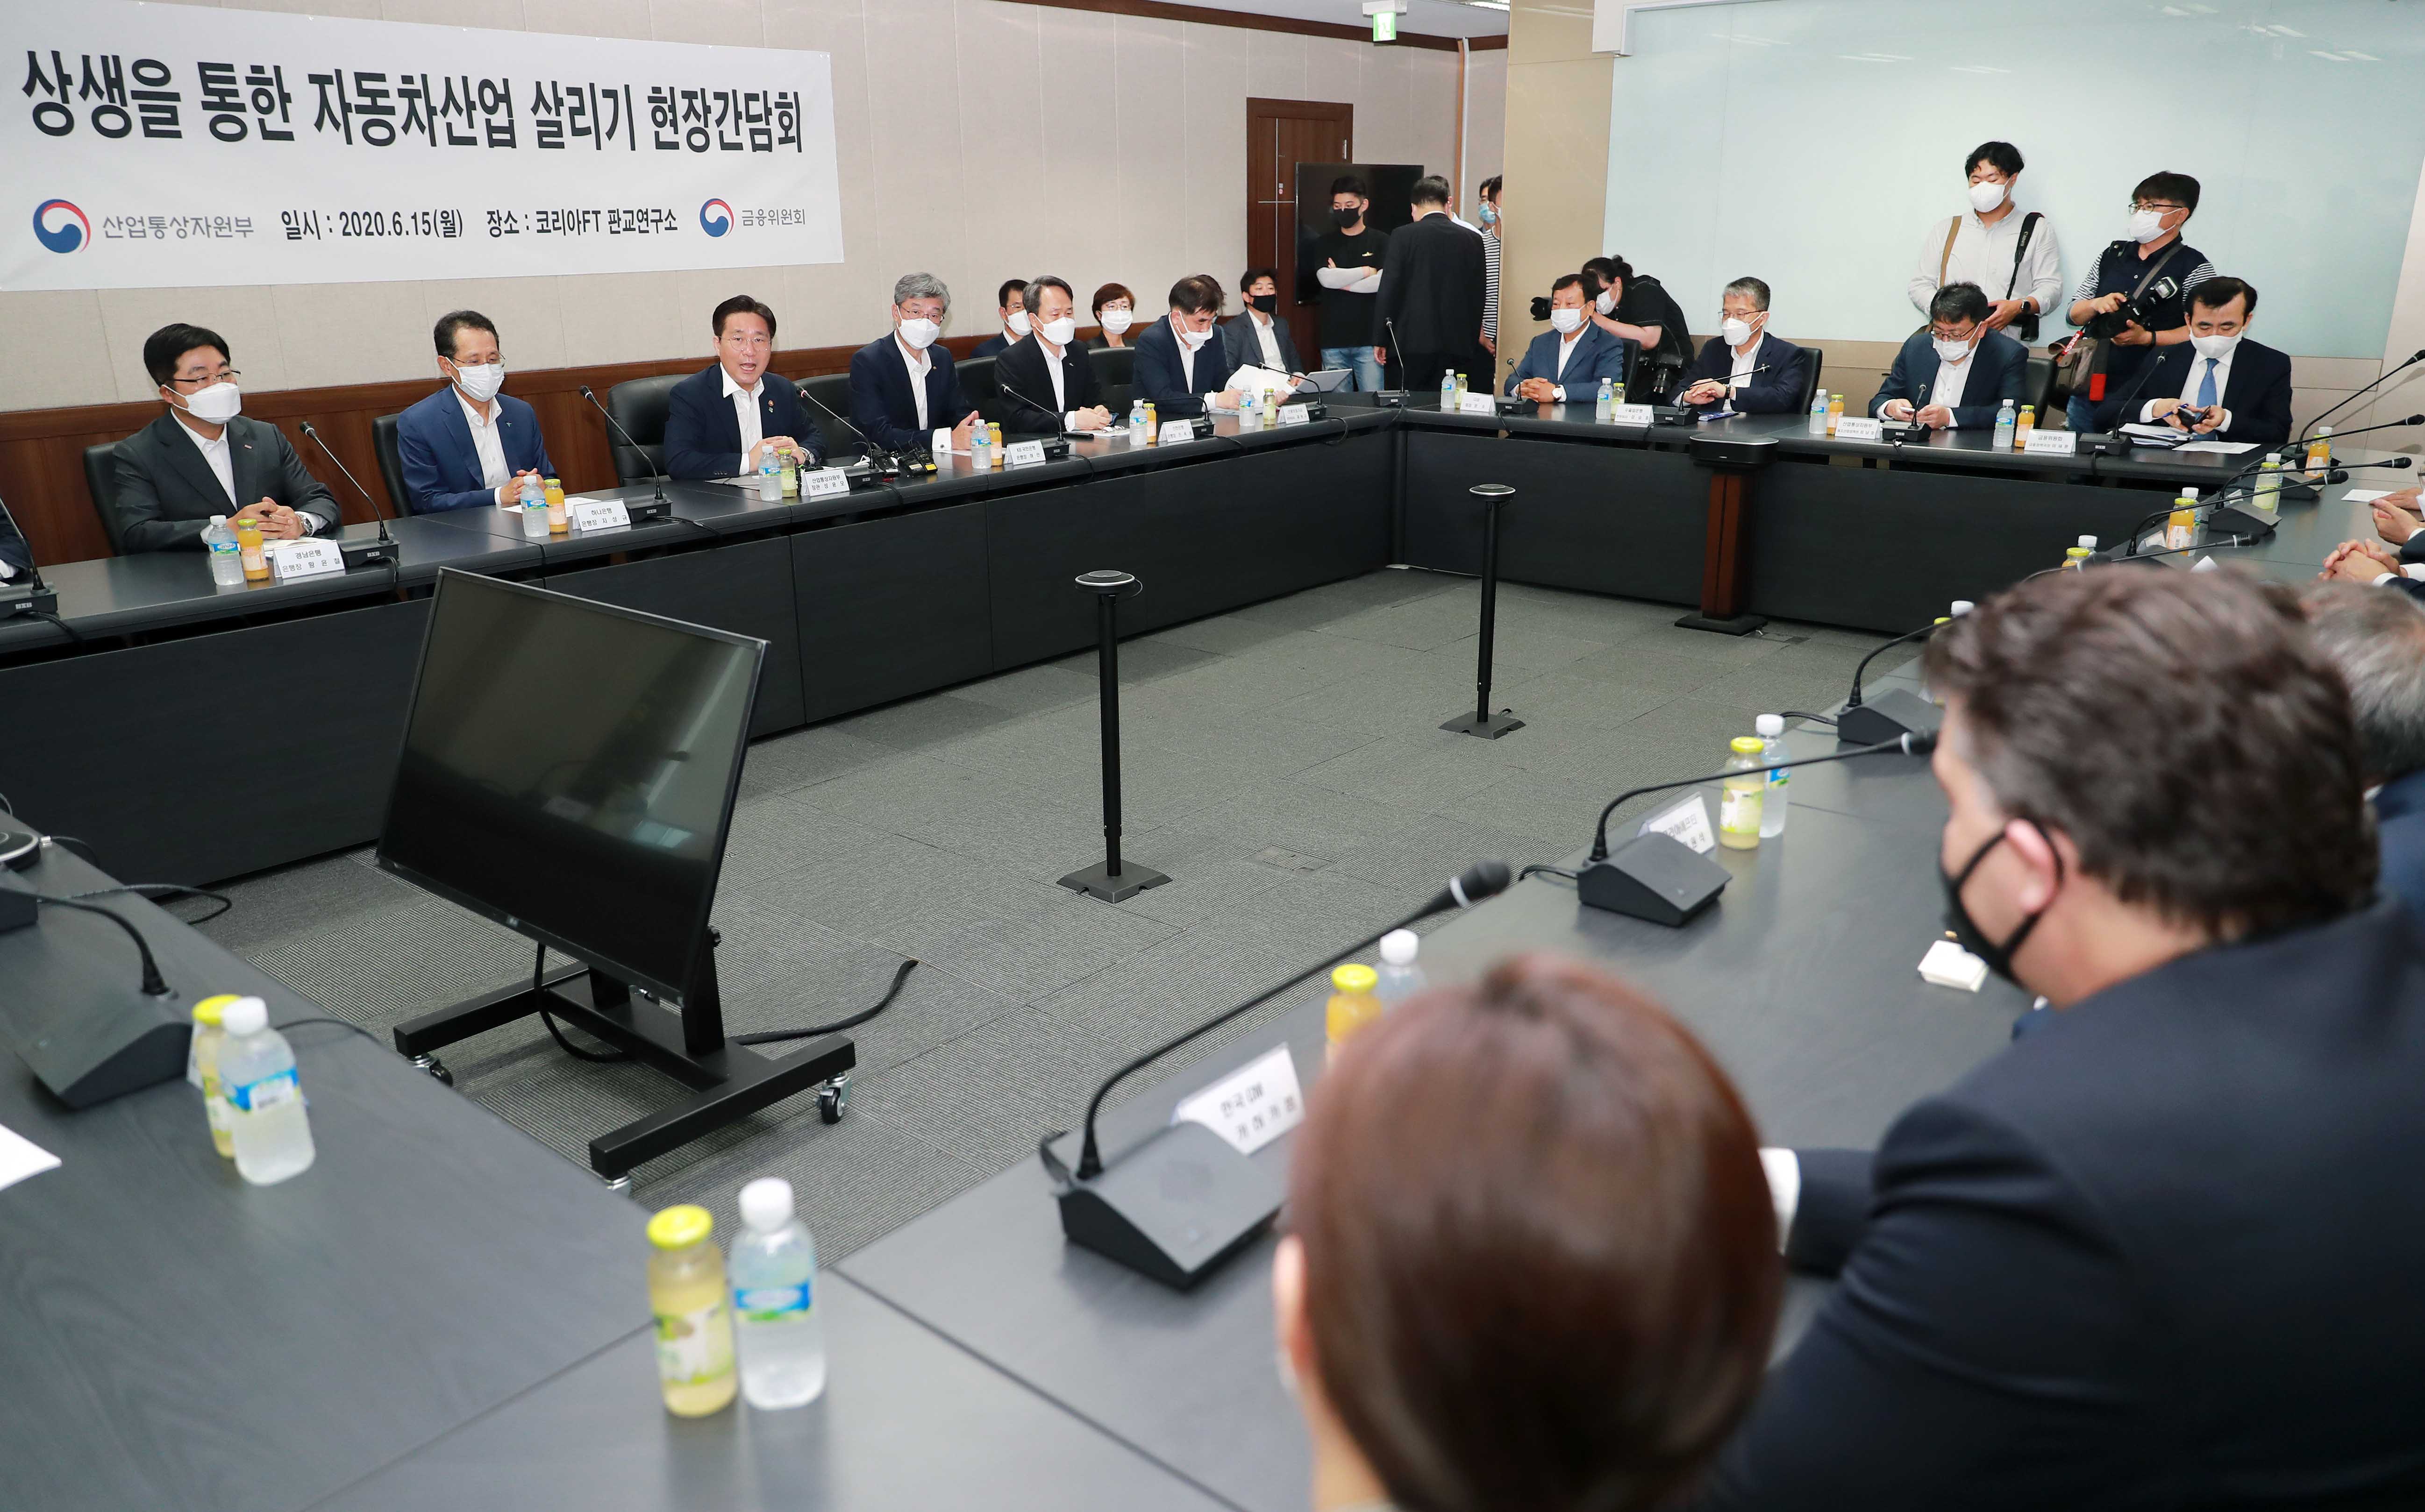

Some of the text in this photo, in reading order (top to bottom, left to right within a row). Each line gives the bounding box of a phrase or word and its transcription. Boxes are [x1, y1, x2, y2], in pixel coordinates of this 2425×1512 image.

[21, 50, 802, 153] 상생을 통한 자동차산업 살리기 현장간담회
[339, 209, 463, 238] 2020.6.15(월)
[536, 209, 601, 236] 코리아FT
[607, 208, 678, 234] 판교연구소
[742, 208, 806, 227] 금융위원회
[103, 215, 254, 240] 산업통상자원부
[2065, 333, 2080, 353] PRESS
[812, 475, 840, 484] 산업통상자원부
[591, 507, 613, 516] 하나은행
[581, 518, 598, 527] 은행장
[295, 549, 322, 560] 경남은행
[282, 563, 302, 573] 은행장
[1664, 813, 1698, 837] 리아에프티
